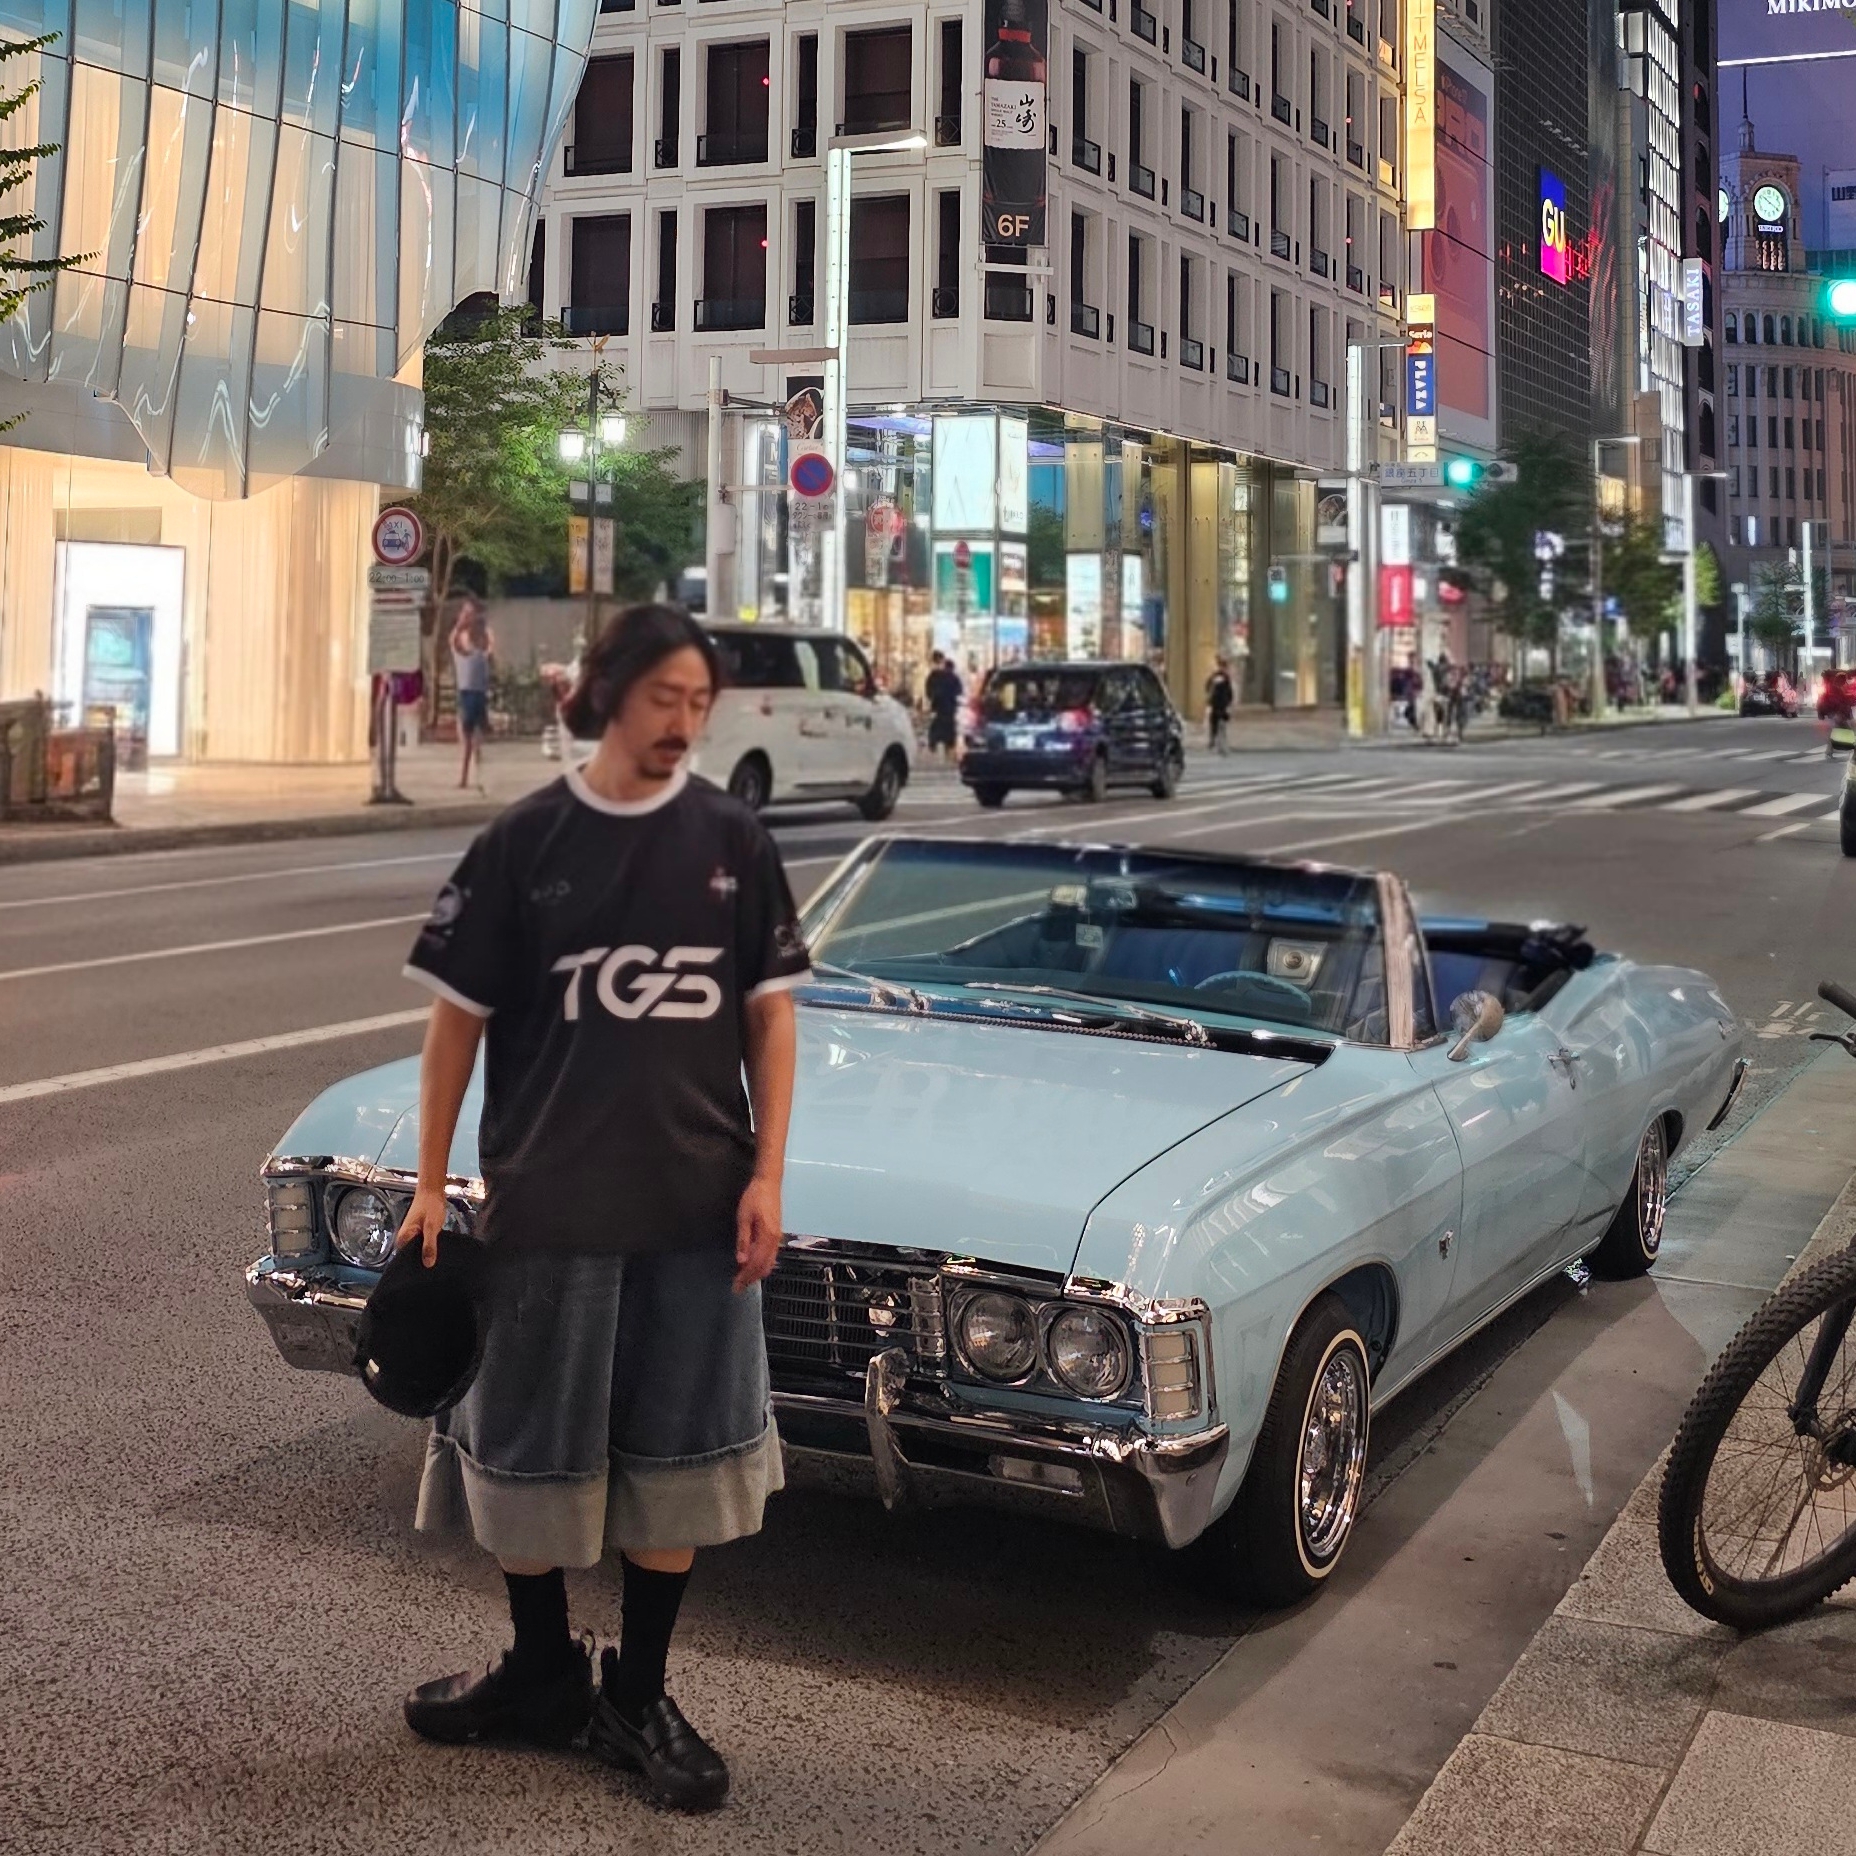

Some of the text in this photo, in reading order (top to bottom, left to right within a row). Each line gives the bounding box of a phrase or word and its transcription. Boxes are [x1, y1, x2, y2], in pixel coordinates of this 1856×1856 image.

[996, 118, 1007, 128] 25
[997, 213, 1030, 237] 6F
[1542, 198, 1565, 253] GU
[1686, 268, 1700, 337] TASAKI
[1414, 360, 1427, 410] PLAZA
[551, 944, 724, 1021] TGS
